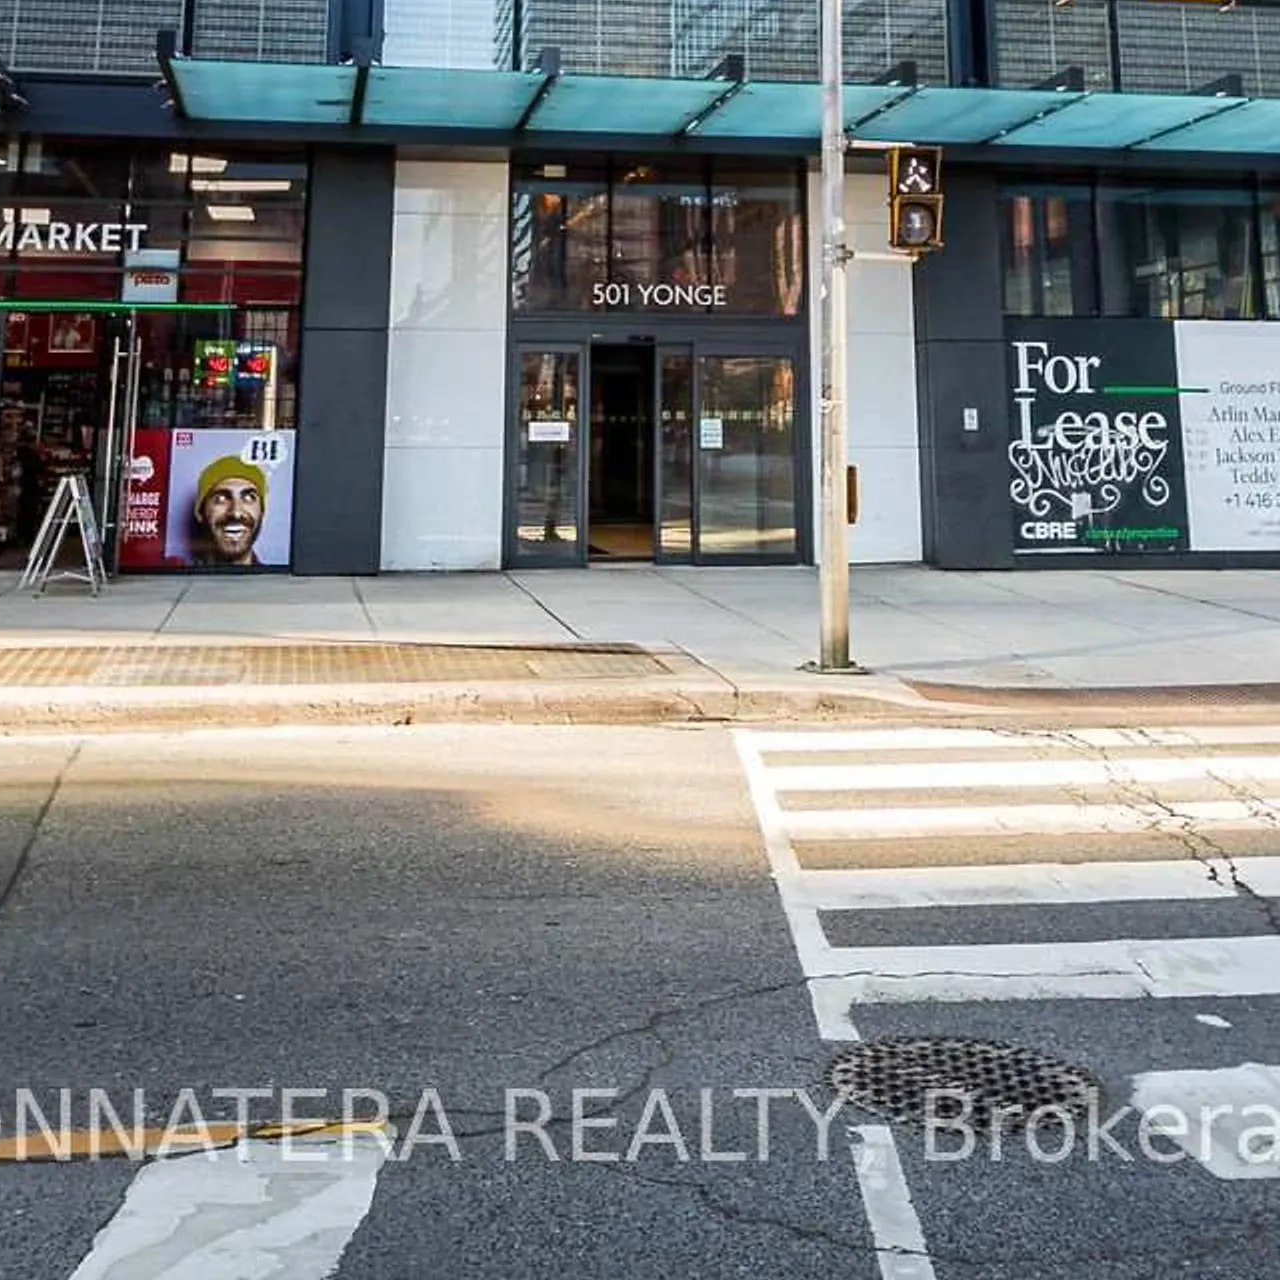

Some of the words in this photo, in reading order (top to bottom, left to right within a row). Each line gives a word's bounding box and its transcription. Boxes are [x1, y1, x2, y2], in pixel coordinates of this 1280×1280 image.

[592, 283, 629, 305] 501
[637, 283, 727, 305] YONGE
[1011, 341, 1101, 393] For
[1220, 382, 1266, 395] Ground
[1209, 405, 1249, 422] Arlin
[1013, 398, 1169, 450] Lease
[1232, 427, 1265, 444] Alex
[1215, 447, 1275, 466] Jackson
[1230, 467, 1278, 487] Teddy
[1224, 493, 1240, 508] +1
[1245, 493, 1272, 509] 416
[1021, 522, 1077, 539] CBRE
